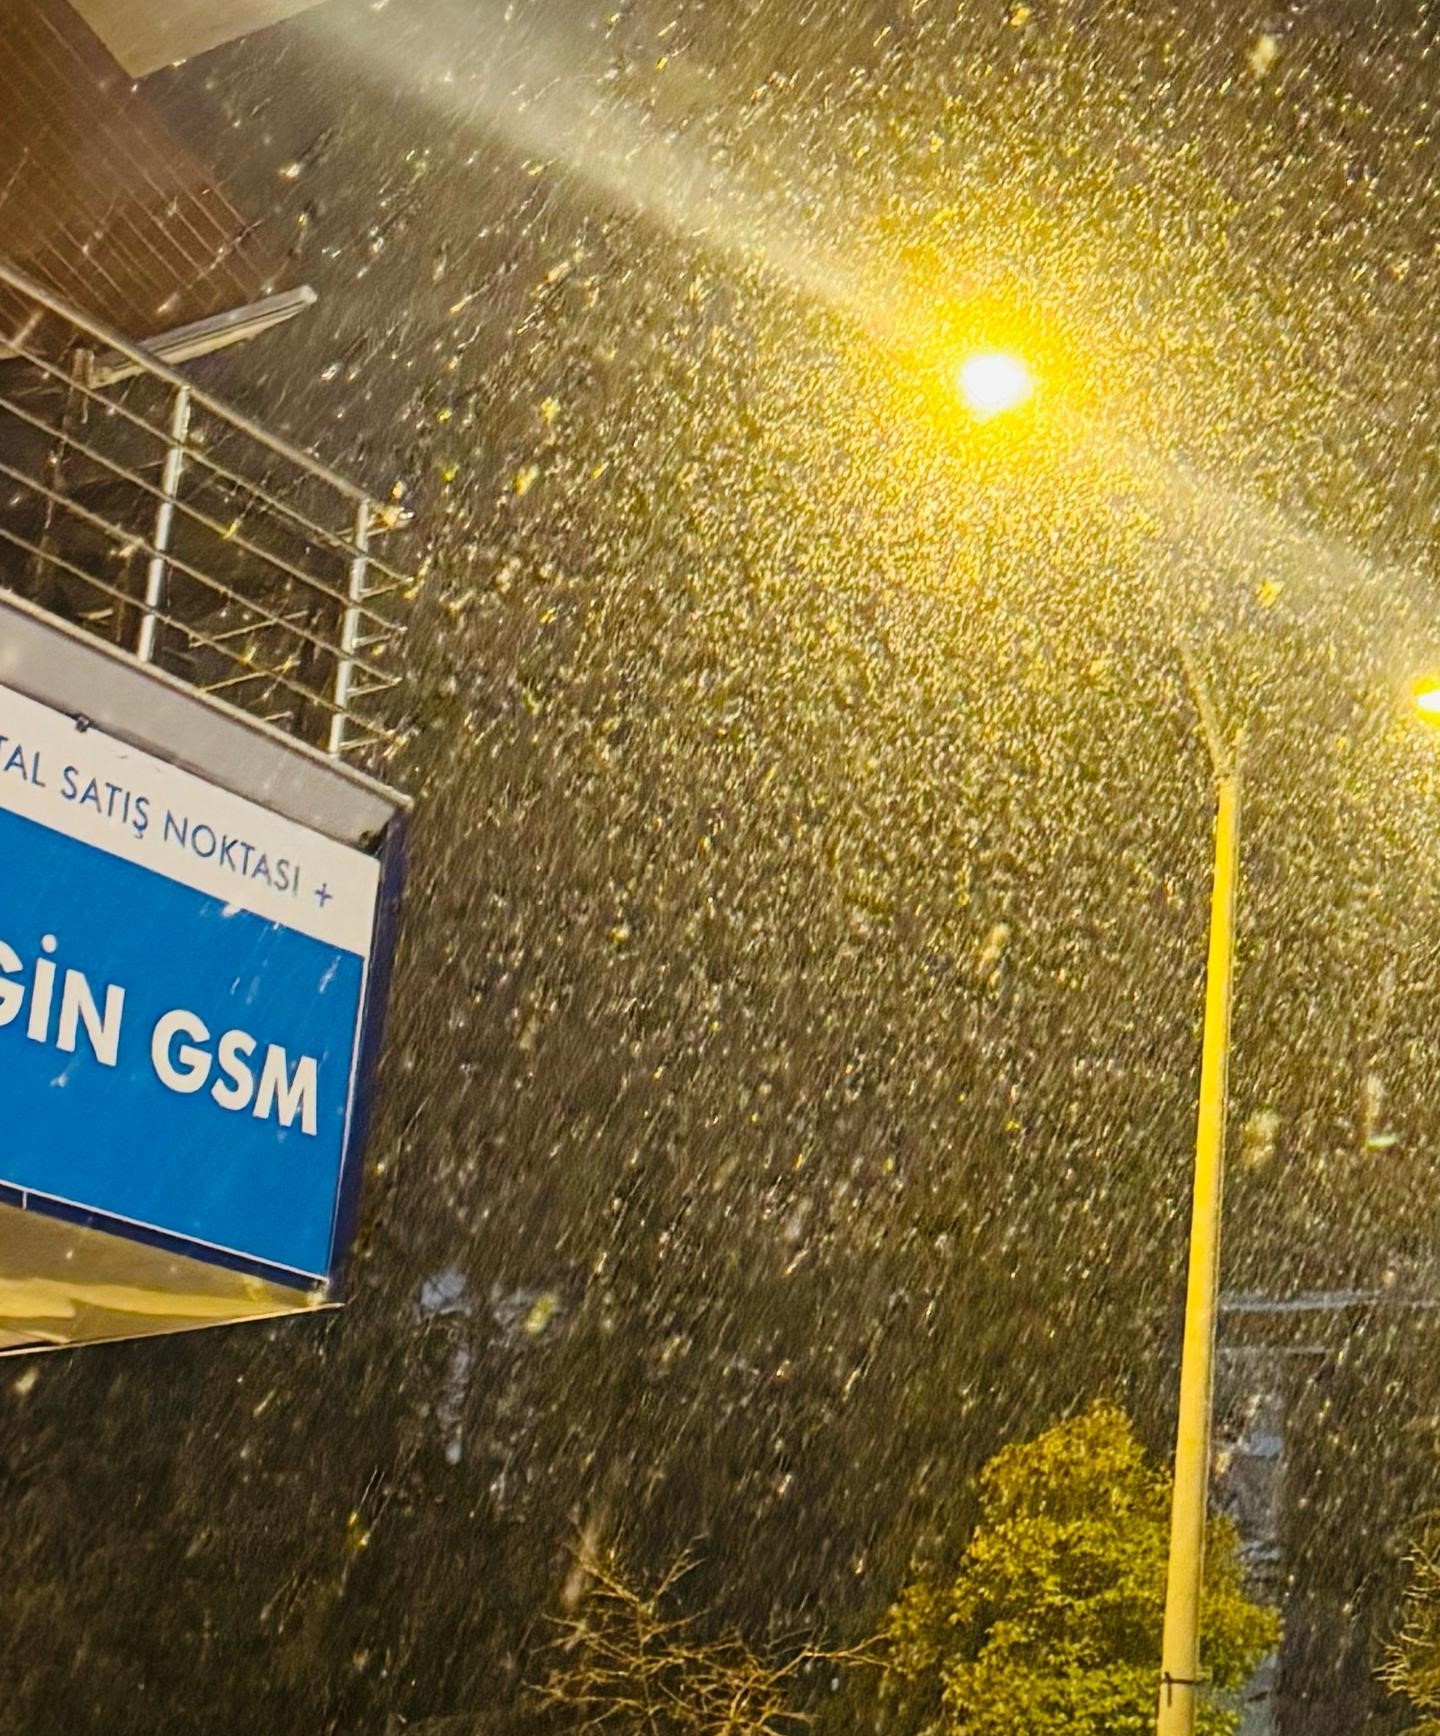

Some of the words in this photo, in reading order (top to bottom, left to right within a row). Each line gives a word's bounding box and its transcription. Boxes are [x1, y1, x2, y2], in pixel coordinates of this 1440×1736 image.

[61, 766, 149, 839] SATIŞ
[164, 809, 300, 897] NOKTASI
[152, 1009, 317, 1136] GSM
